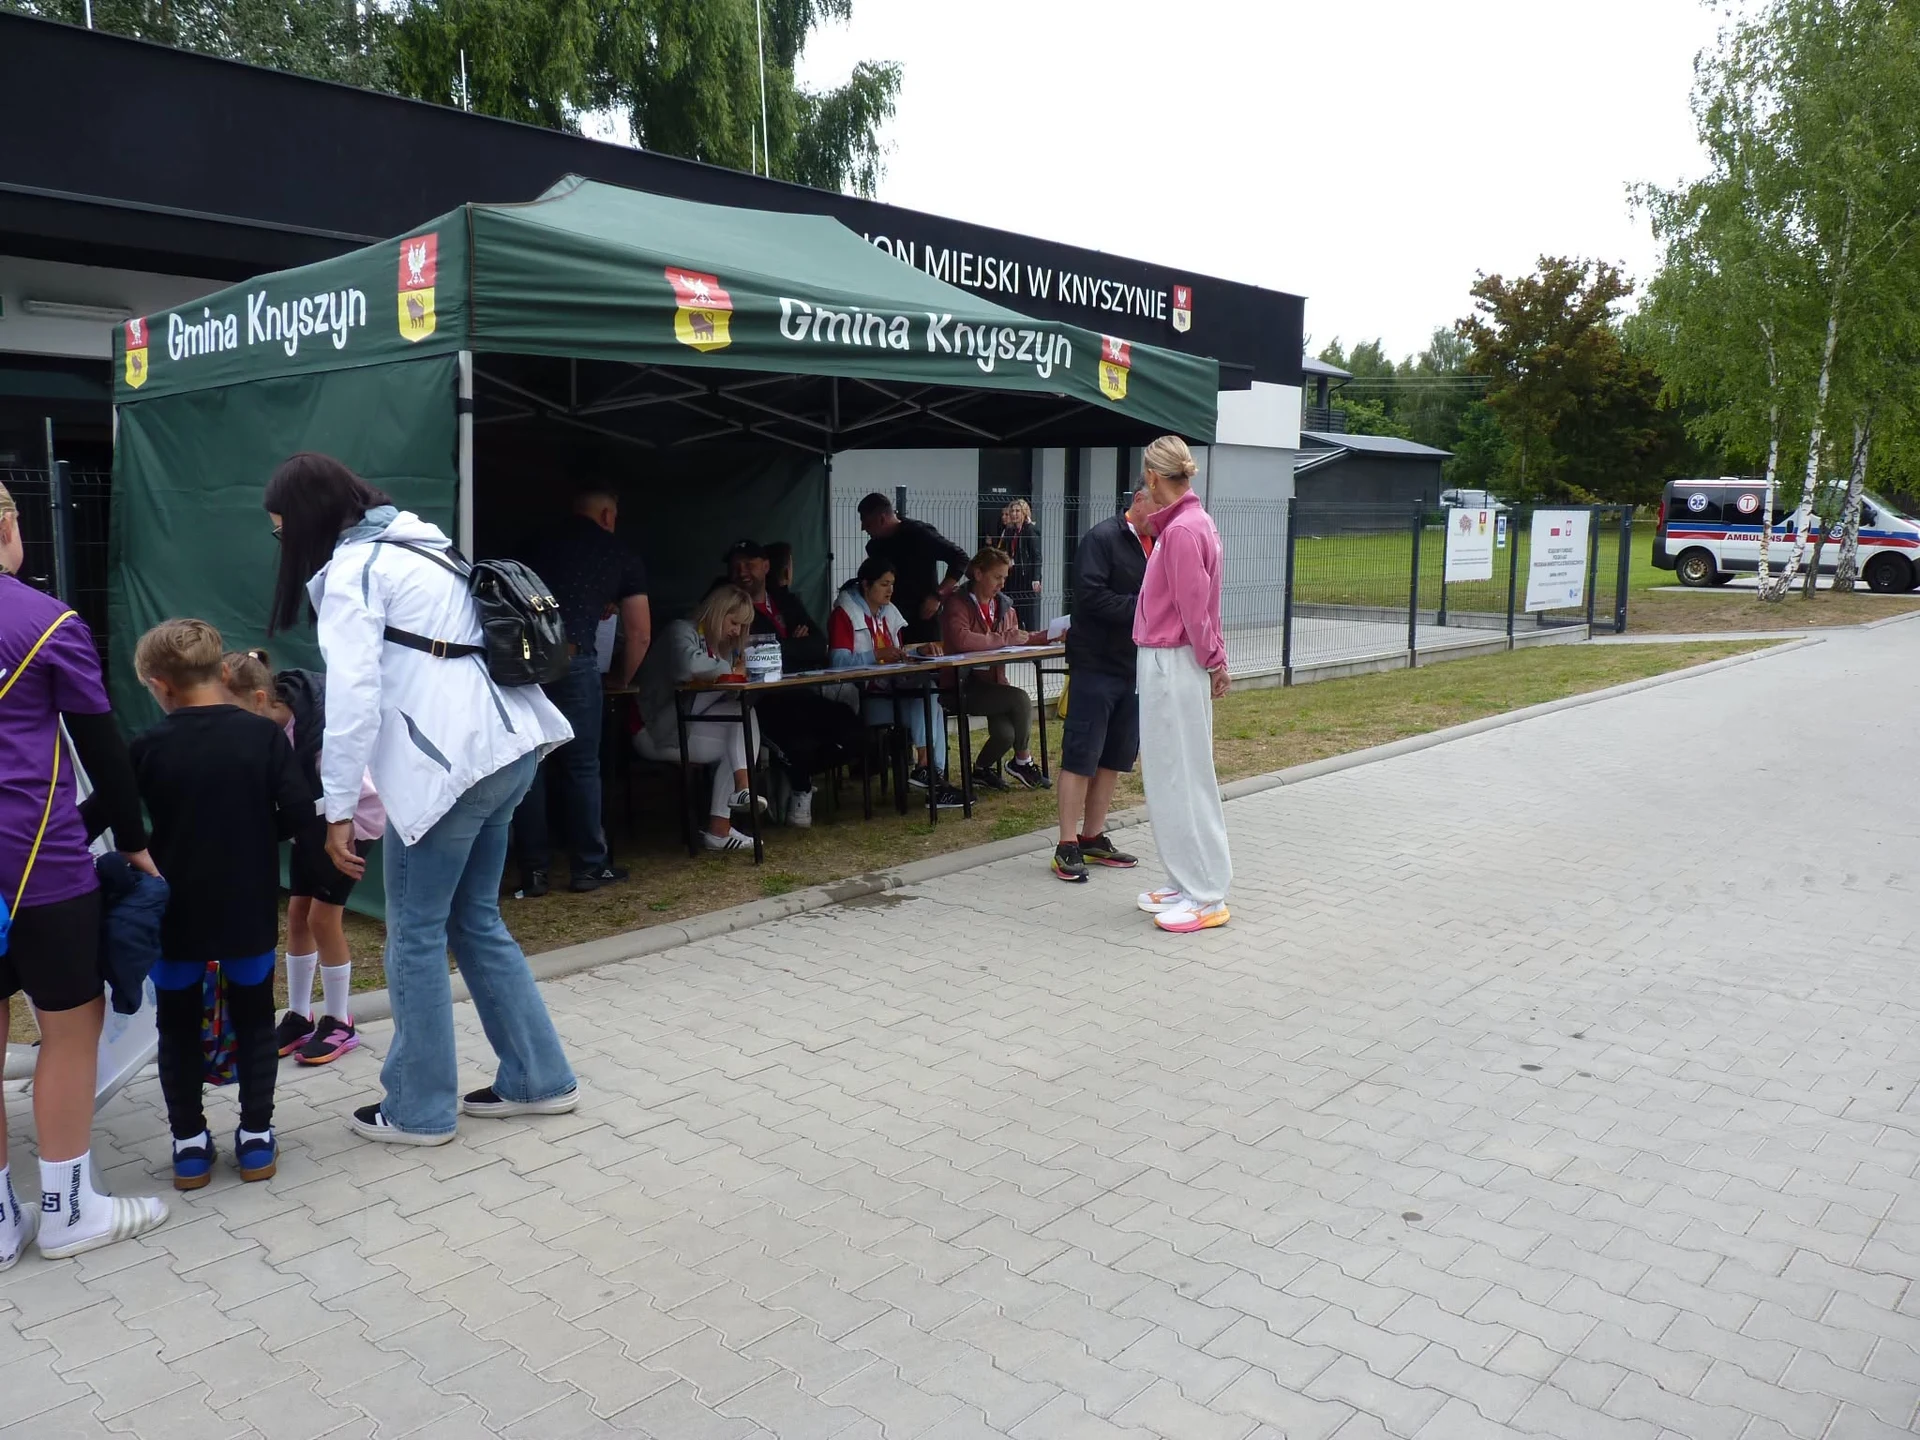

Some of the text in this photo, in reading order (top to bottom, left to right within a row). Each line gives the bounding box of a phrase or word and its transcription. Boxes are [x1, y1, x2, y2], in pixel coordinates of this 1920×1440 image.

[864, 232, 1168, 320] ON MIEJSKI W KNYSZYNIE
[168, 288, 366, 361] Gmina Knyszyn
[779, 296, 1073, 379] Gmina Knyszyn
[1726, 533, 1783, 543] AMBULNS
